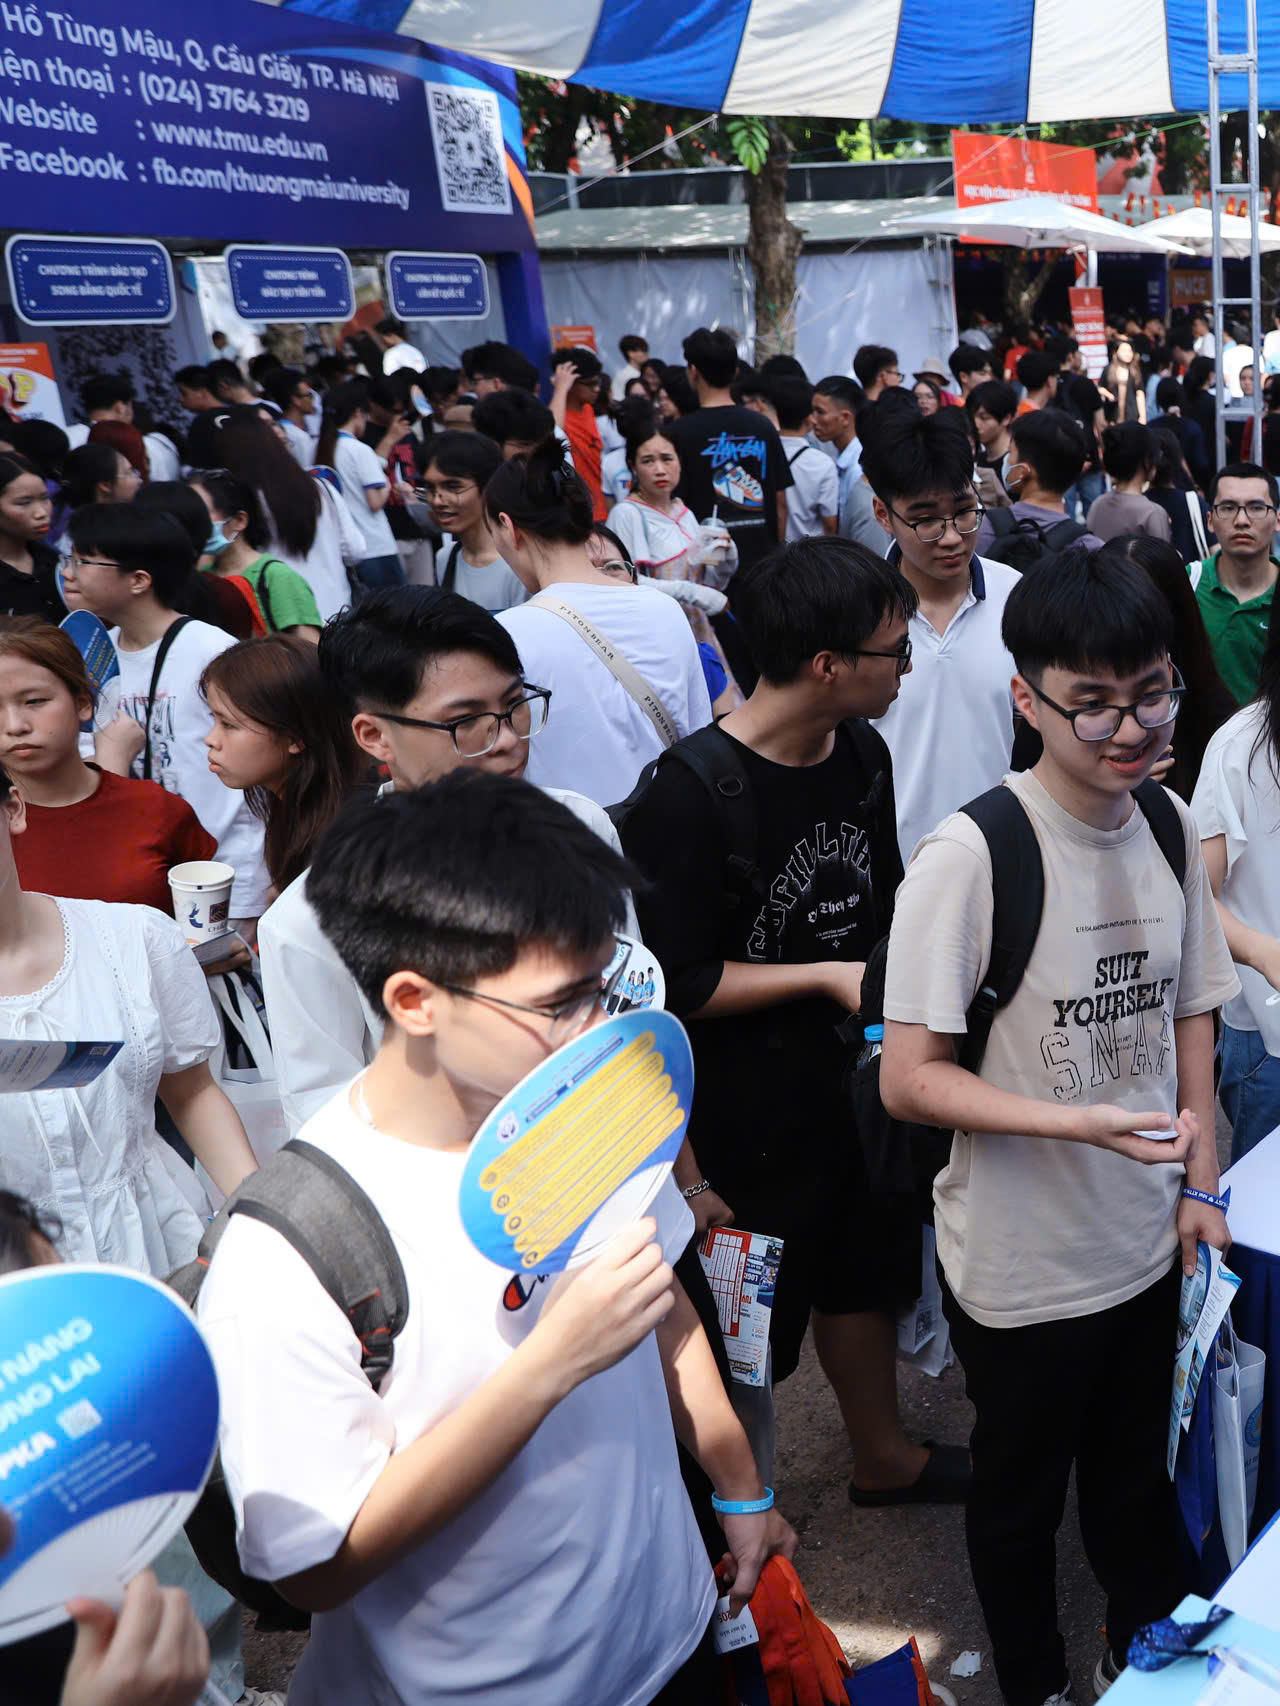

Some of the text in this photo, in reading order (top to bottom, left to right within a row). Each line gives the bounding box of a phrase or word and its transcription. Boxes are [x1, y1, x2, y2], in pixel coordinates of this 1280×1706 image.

[1, 2, 400, 105] Hồ Tùng Mậu, Q. Cầu Giấy, TP. Hà Nội
[45, 57, 115, 98] thoại
[139, 71, 203, 113] (024)
[205, 83, 262, 115] 3764
[263, 92, 310, 122] 3219
[151, 121, 329, 161] www.tmu.edu.vn
[152, 157, 410, 210] fb.com/thuongmaiuniversity
[559, 605, 615, 661] PITON BEAR
[644, 695, 667, 725] PITON
[1095, 950, 1149, 989] SUIT
[1053, 977, 1175, 1027] YOURSELF
